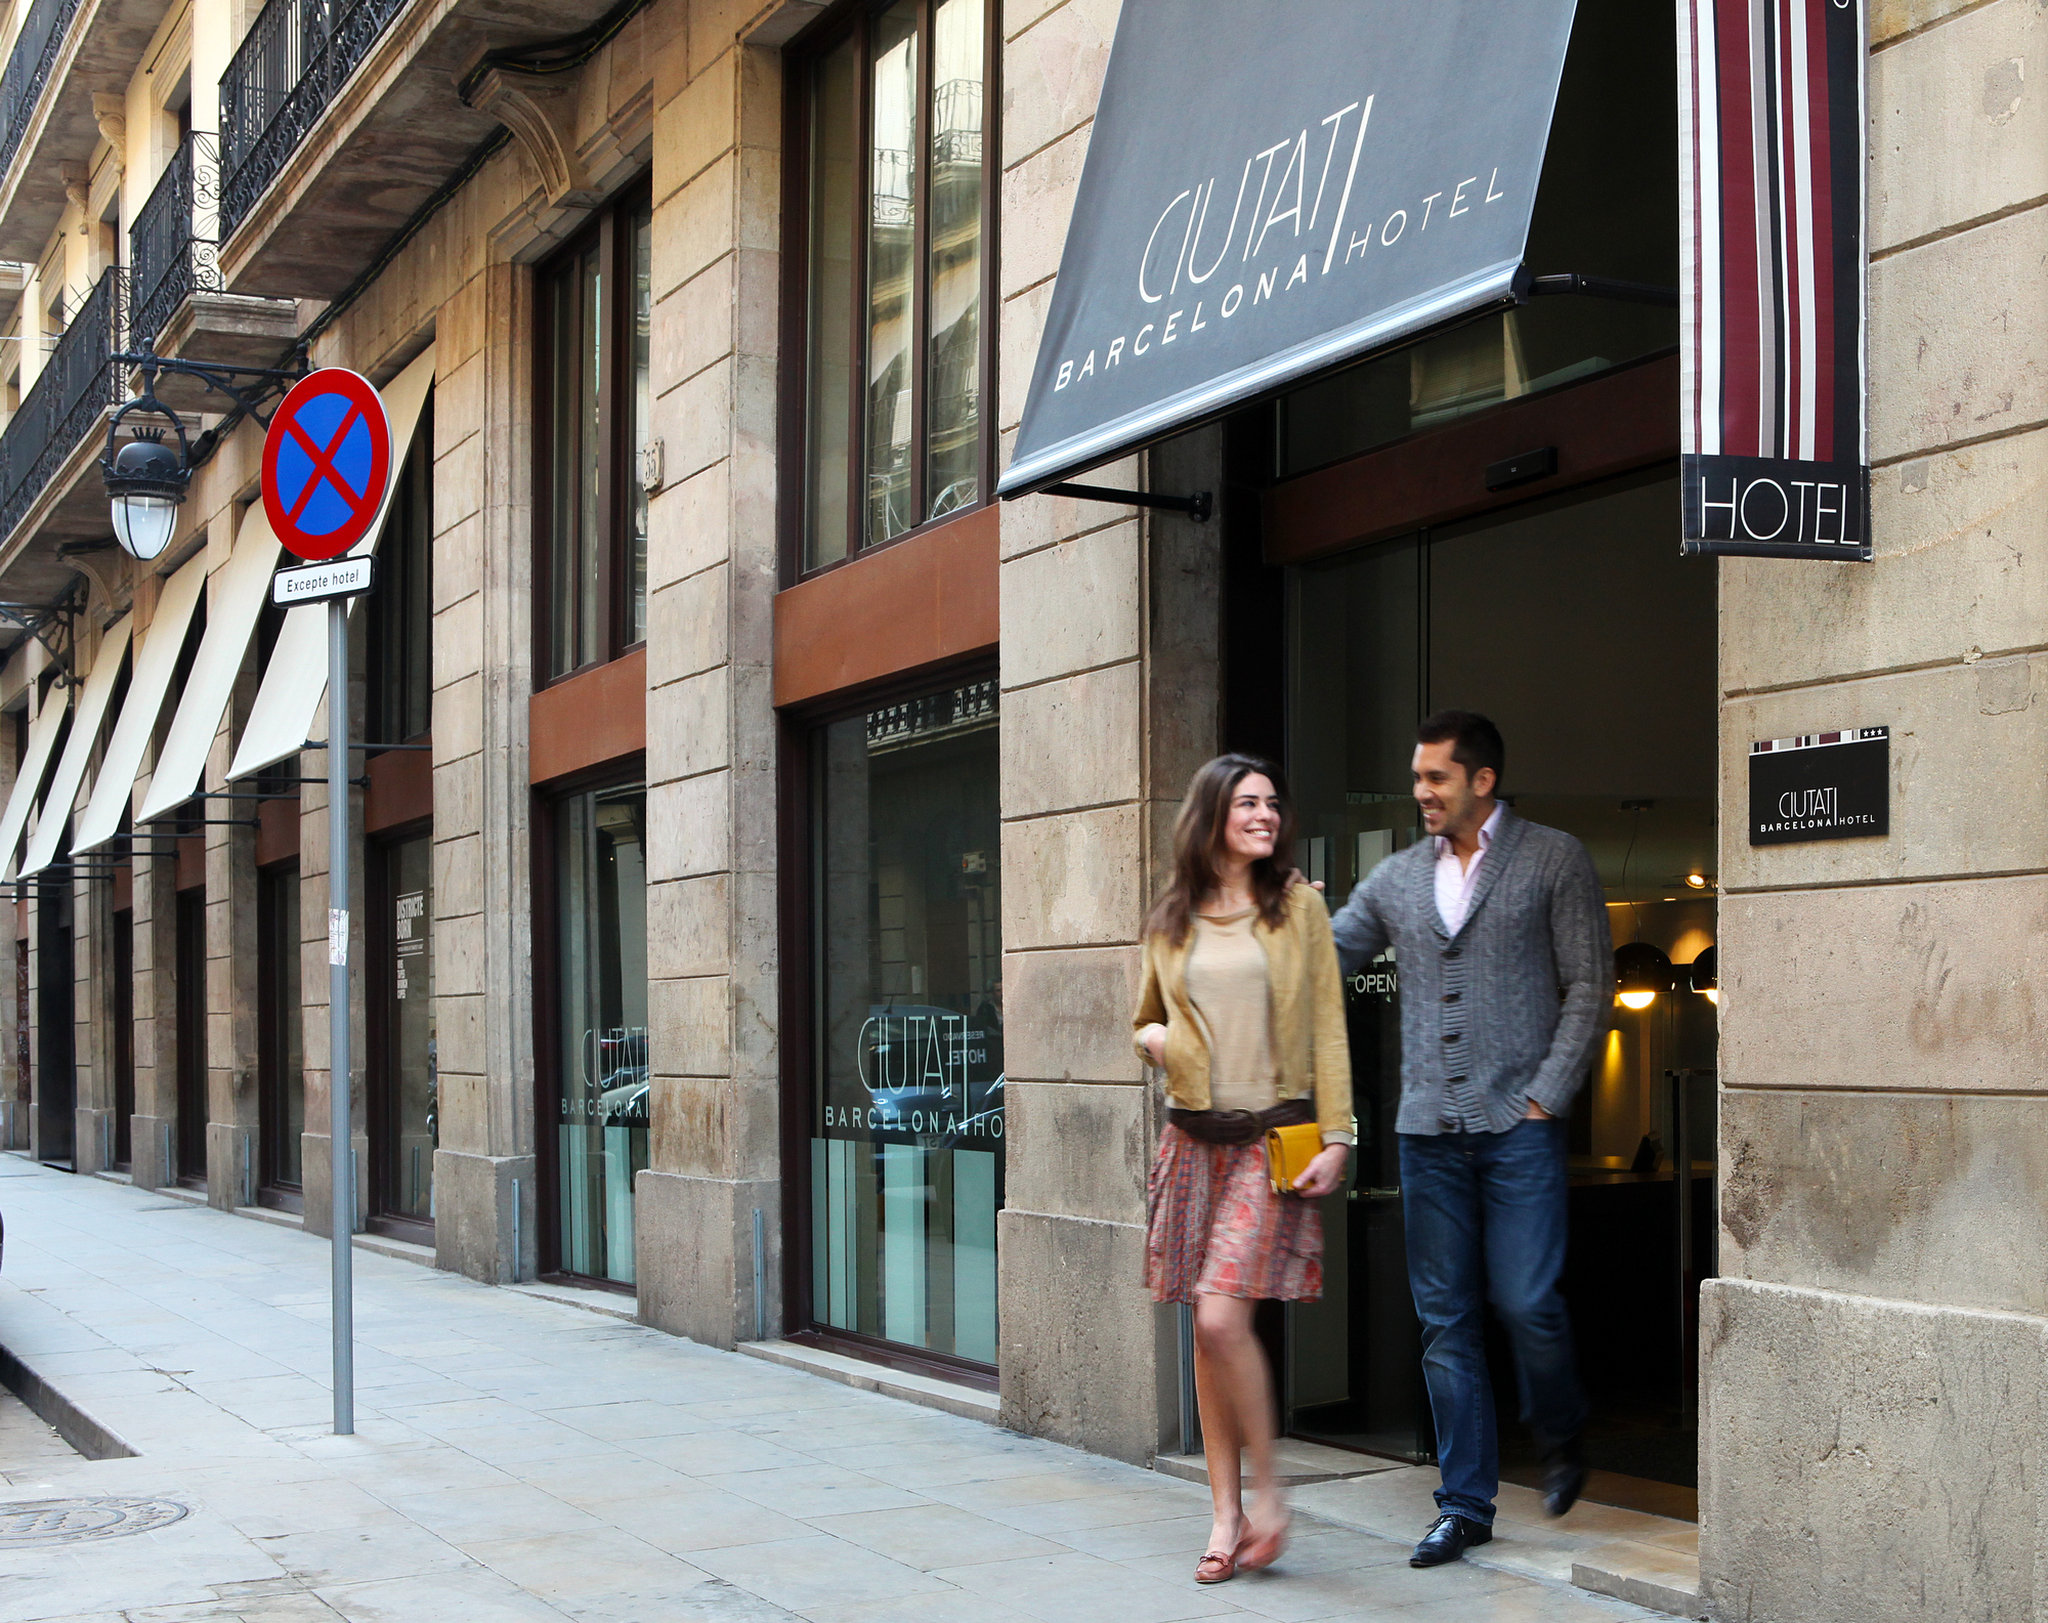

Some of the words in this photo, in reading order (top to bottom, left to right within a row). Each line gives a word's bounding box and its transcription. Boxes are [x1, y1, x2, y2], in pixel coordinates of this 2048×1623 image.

[1139, 99, 1362, 303] CIUTAT
[1054, 253, 1308, 393] BARCELONA
[1345, 167, 1504, 265] HOTEL
[1701, 476, 1861, 546] HOTEL
[287, 576, 329, 593] Excepte
[332, 568, 360, 586] hotel
[1779, 787, 1834, 819] CIUTAT
[1760, 818, 1832, 833] BARCELONA
[1839, 814, 1876, 826] HOTEL
[1355, 974, 1397, 993] OPEN
[582, 1027, 643, 1089] CIUTAT
[857, 1015, 961, 1096] CIUTAT
[561, 1098, 643, 1118] BARCELONA
[825, 1106, 958, 1136] BARCELONA
